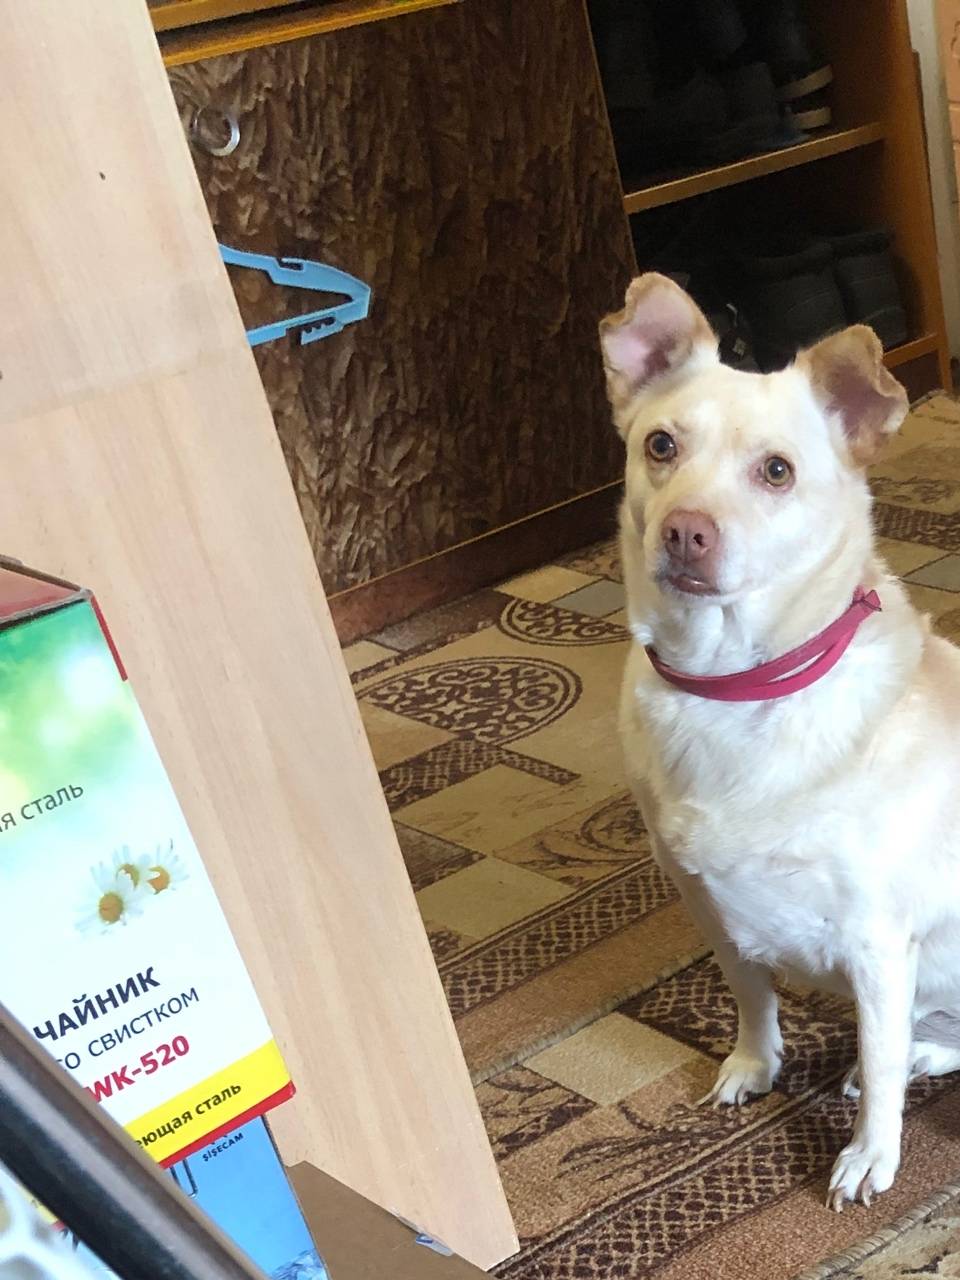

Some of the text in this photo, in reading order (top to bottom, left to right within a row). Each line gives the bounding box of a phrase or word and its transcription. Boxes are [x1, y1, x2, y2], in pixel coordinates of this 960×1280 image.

[0, 784, 84, 833] я сталь
[33, 966, 161, 1041] ЧАЙНИК
[88, 987, 200, 1057] СВИСТКОМ
[83, 1035, 190, 1103] WK-520
[195, 1084, 242, 1115] сталь
